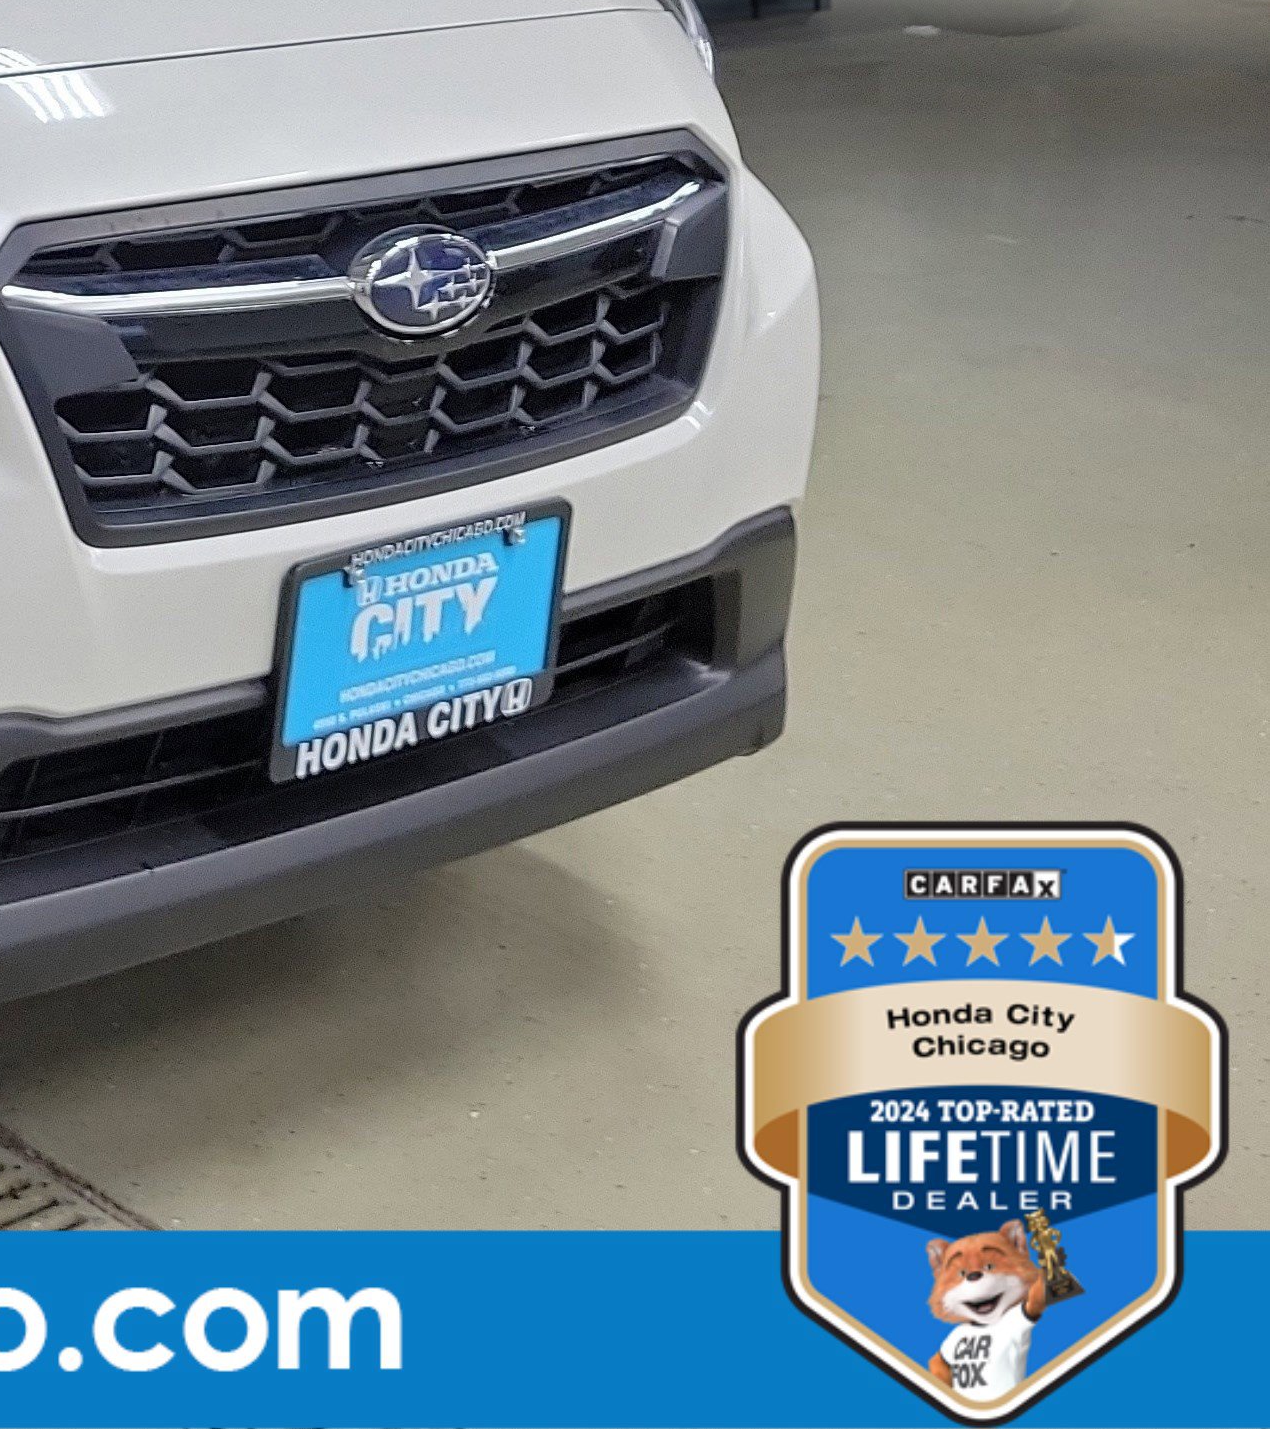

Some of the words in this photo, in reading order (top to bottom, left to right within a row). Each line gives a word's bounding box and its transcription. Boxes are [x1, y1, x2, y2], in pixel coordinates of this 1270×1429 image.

[382, 553, 499, 597] HONDA
[350, 576, 498, 662] CITY
[295, 712, 418, 779] HONDA
[427, 685, 502, 739] CITY
